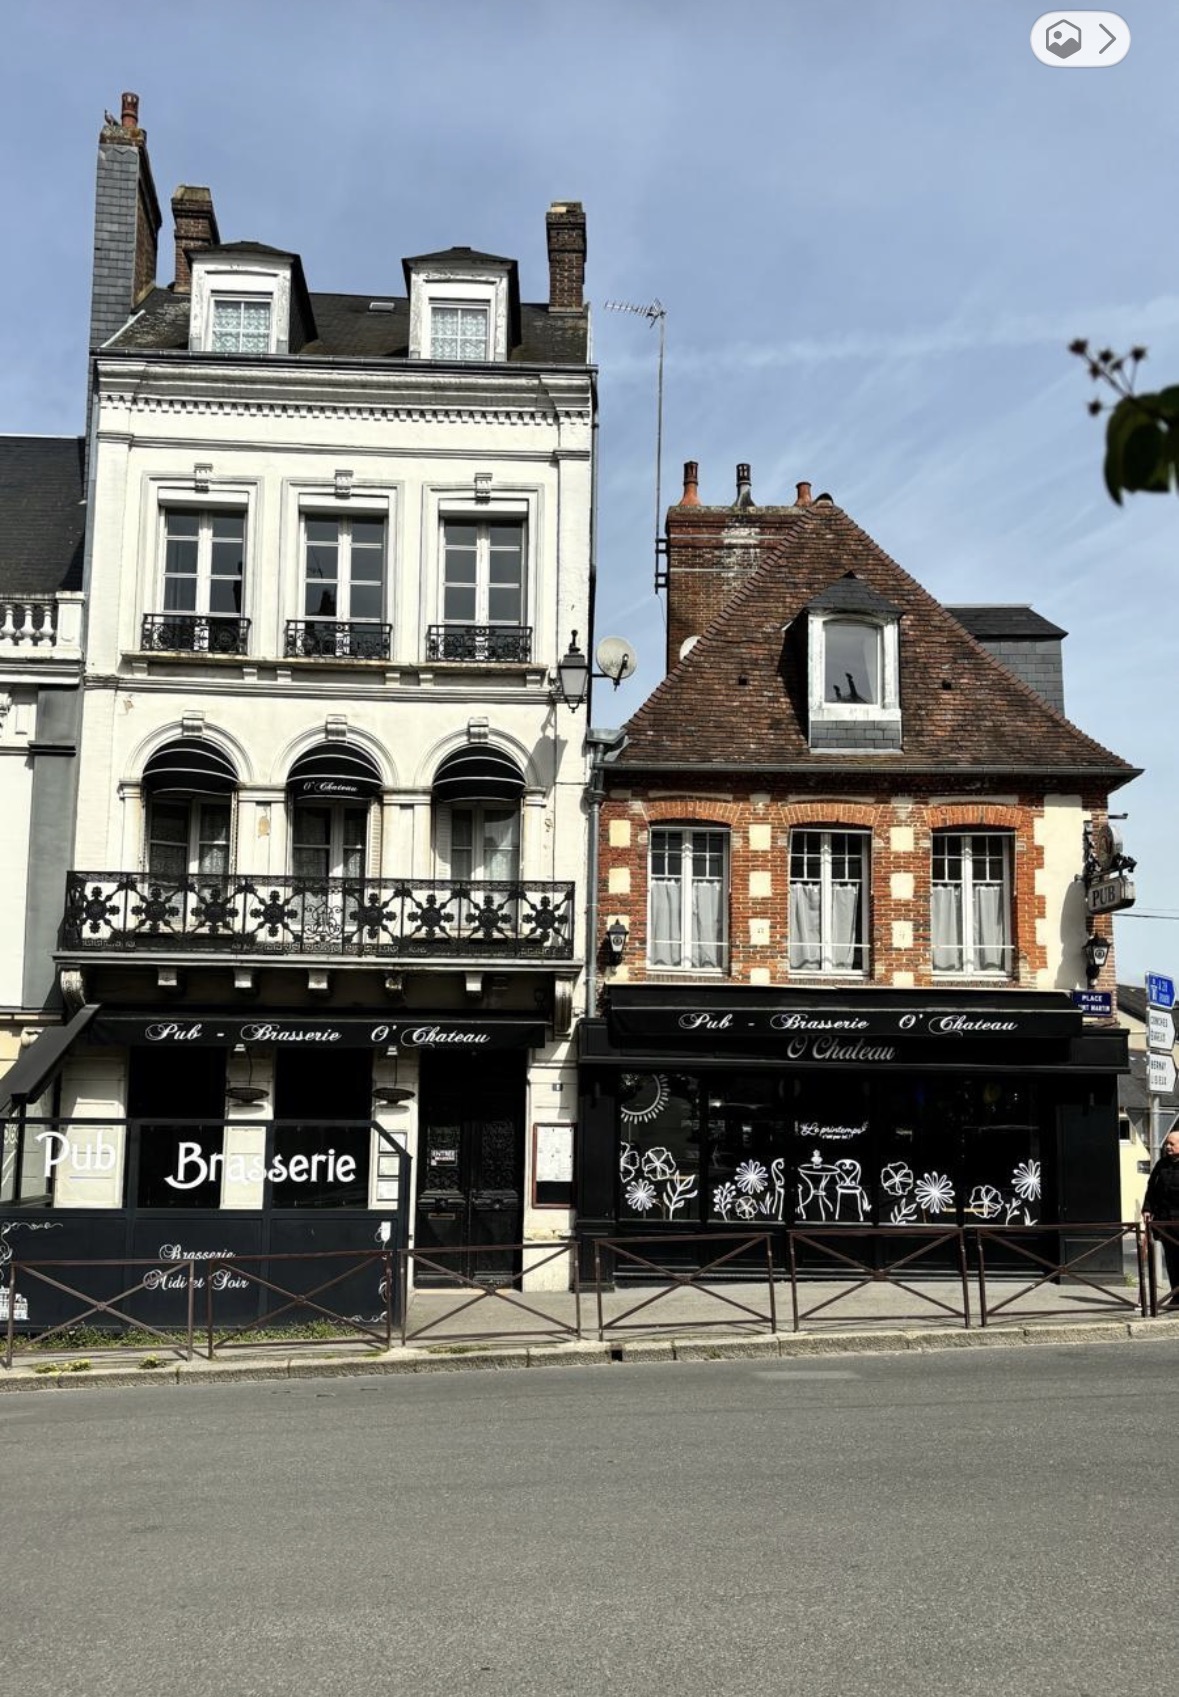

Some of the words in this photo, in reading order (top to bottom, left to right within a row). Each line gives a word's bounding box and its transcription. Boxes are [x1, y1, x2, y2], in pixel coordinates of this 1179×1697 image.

[1092, 885, 1116, 908] PUB
[145, 1022, 202, 1041] Pub
[240, 1023, 342, 1041] Brasserie
[371, 1025, 397, 1042] O'
[400, 1026, 490, 1048] Chateau
[678, 1012, 733, 1030] Pub
[769, 1013, 870, 1030] Brasserie
[899, 1014, 923, 1030] O'
[928, 1014, 1018, 1037] Chateau
[819, 1125, 862, 1138] printemps
[35, 1131, 115, 1178] Pub
[164, 1141, 357, 1189] Brasserie
[159, 1244, 236, 1260] Brasserie
[211, 1269, 249, 1290] Soir
